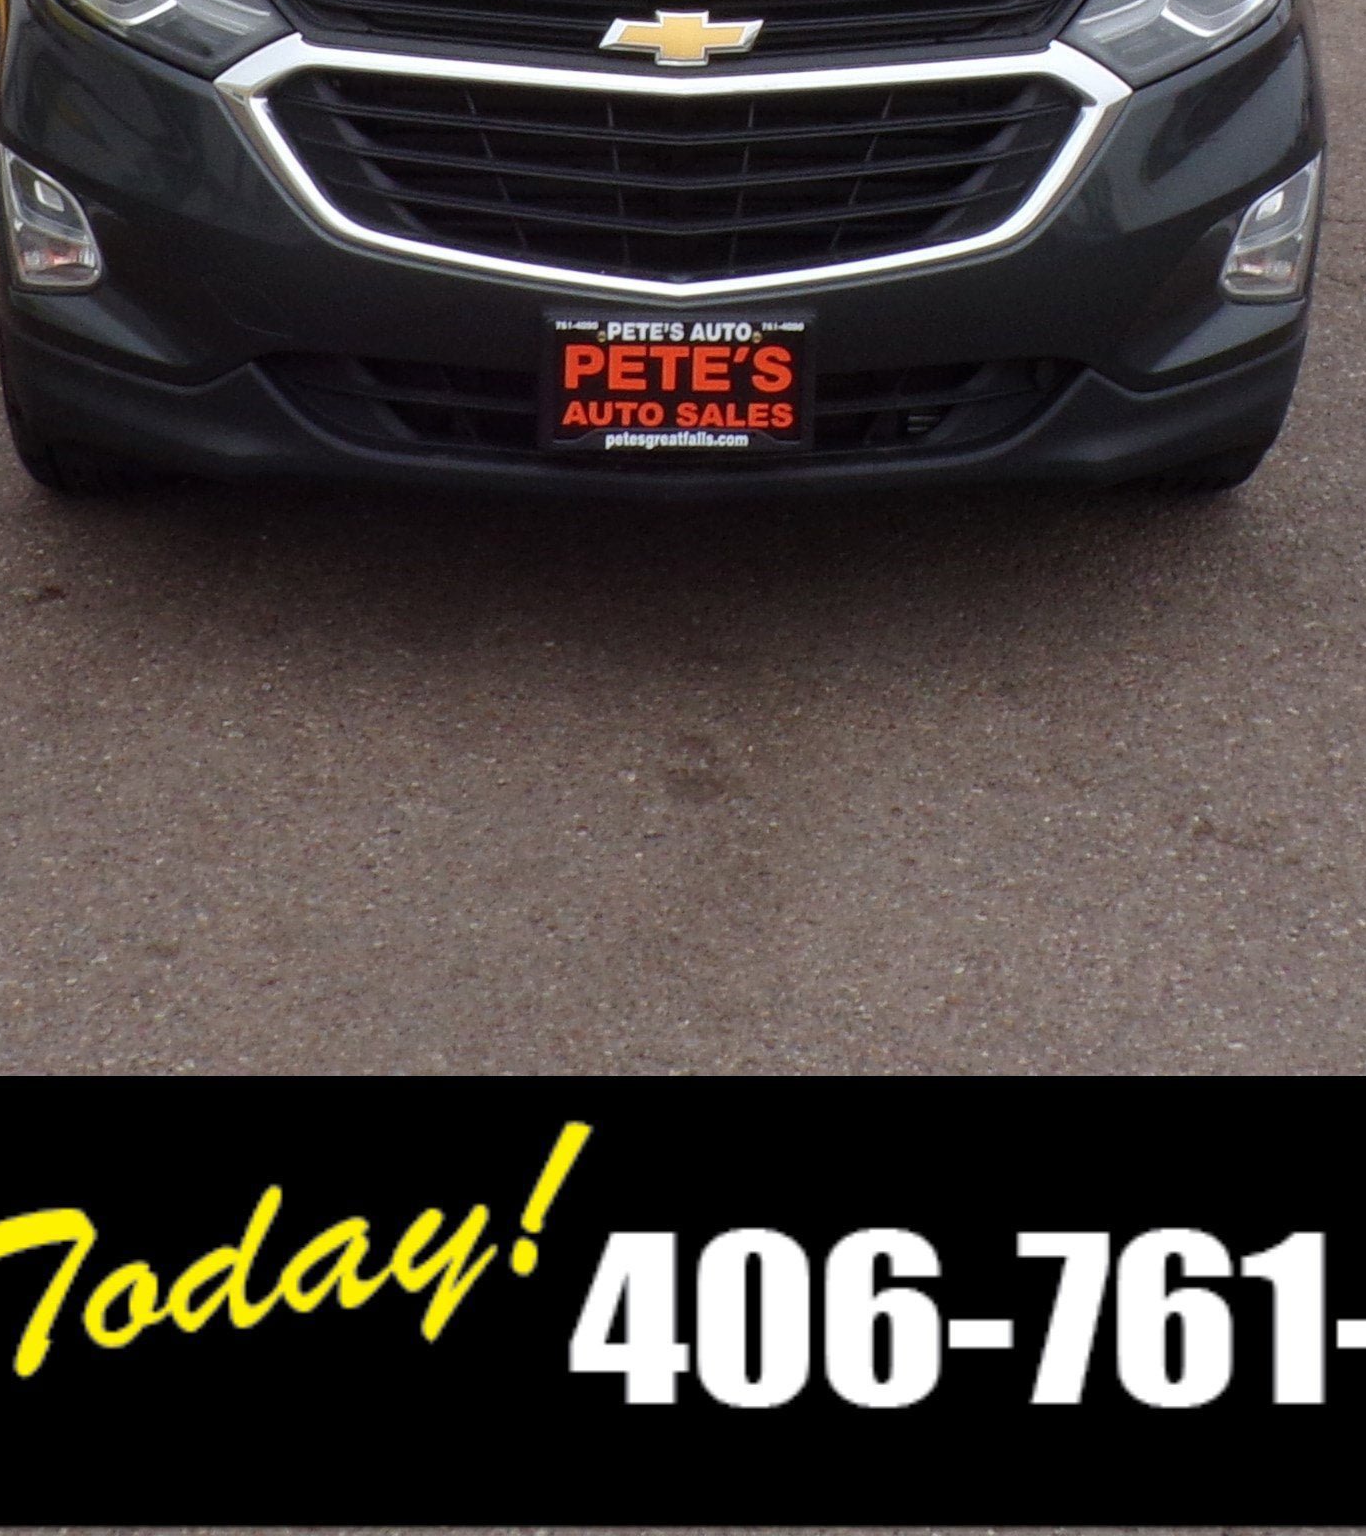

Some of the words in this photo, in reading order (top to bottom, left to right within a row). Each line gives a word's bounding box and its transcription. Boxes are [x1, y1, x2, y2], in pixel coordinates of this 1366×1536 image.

[607, 321, 684, 342] PETE'S
[689, 322, 752, 342] AUTO
[564, 344, 793, 392] PETE'S
[561, 401, 665, 427] AUTO
[675, 402, 794, 428] SALES
[605, 430, 750, 450] petesgreatfalls.com
